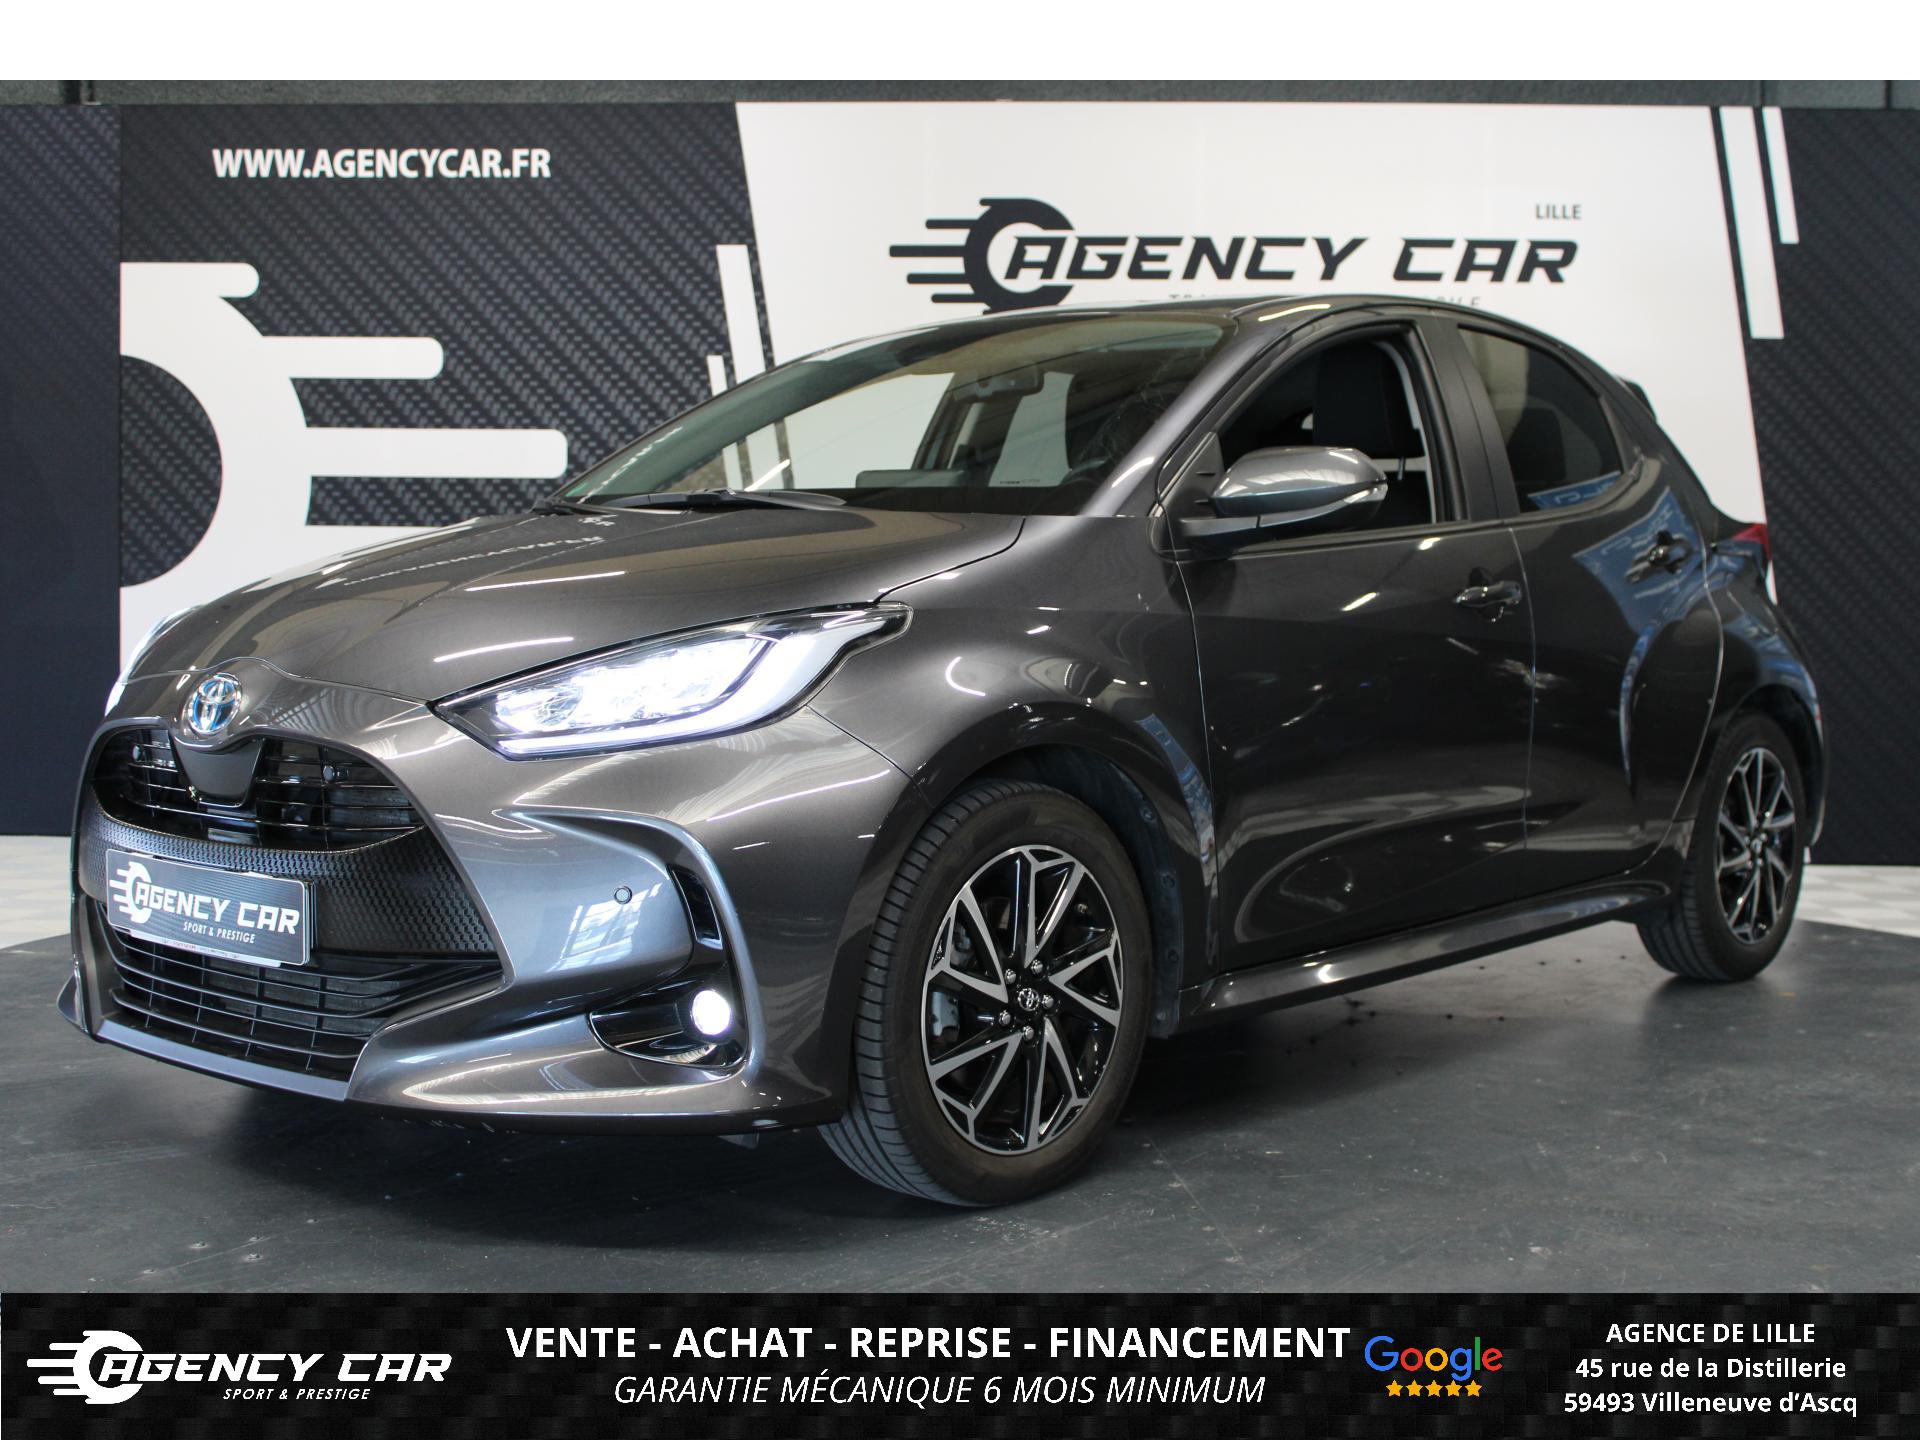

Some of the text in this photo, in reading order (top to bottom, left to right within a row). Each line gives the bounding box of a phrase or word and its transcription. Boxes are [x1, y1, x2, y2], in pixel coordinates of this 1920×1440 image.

[213, 148, 551, 179] WWW.AGENCYCAR.FR
[1535, 204, 1583, 221] LILLE
[1004, 236, 1579, 283] AGENCY CAR
[135, 881, 300, 935] AGENCY CAR
[183, 921, 208, 935] SPORT
[216, 928, 256, 944] PRESTIGE
